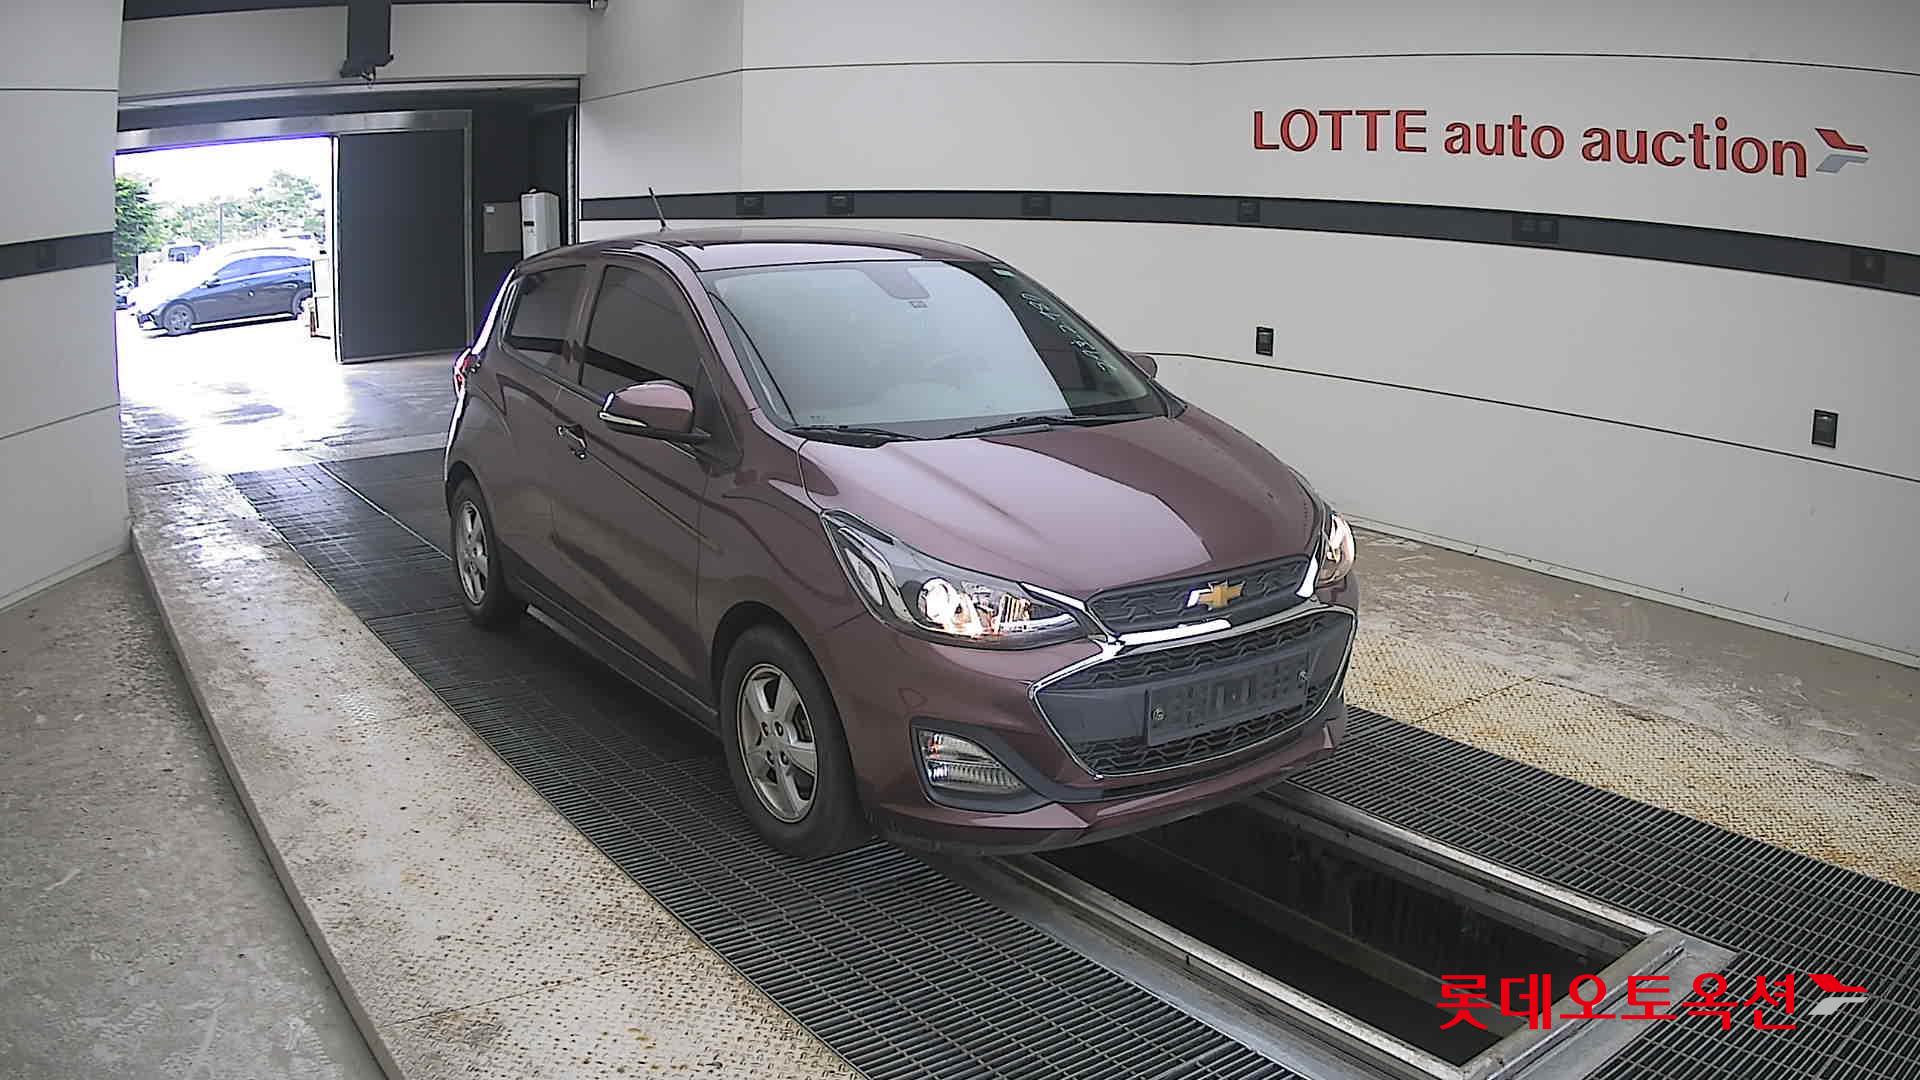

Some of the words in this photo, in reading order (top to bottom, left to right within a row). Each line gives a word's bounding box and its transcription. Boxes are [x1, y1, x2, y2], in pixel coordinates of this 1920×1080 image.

[1254, 109, 1428, 153] LOTTE
[1444, 115, 1565, 159] auto
[1581, 116, 1808, 178] auction
